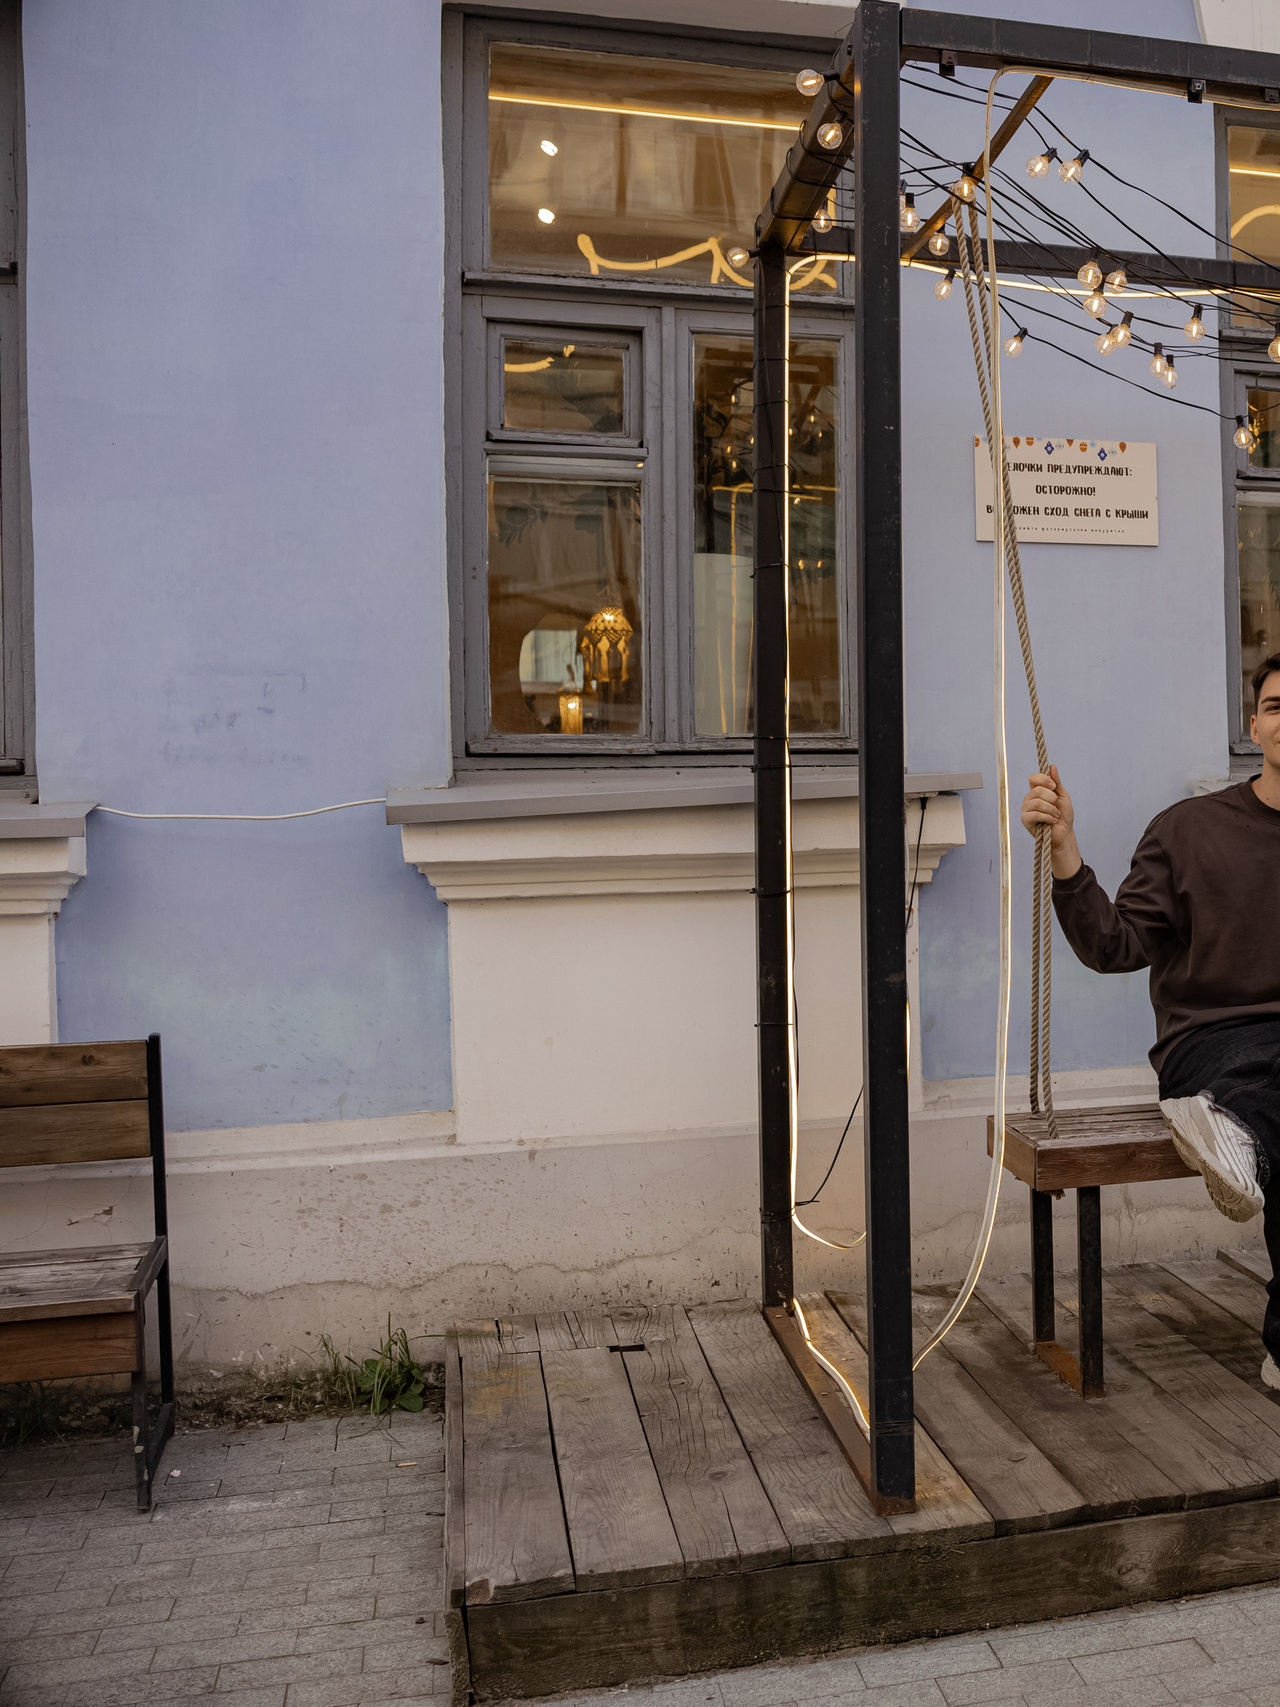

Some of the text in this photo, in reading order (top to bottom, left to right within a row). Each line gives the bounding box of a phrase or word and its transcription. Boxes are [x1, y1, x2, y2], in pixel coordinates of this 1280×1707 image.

[1006, 462, 1133, 477] ЕЛОЧКИ ПРЕДУПРЕЖДАЮТ:
[1035, 484, 1096, 496] ОСТОРОЖНО!
[986, 504, 1149, 519] ВОЖЕН СХОД СНЕГА С КРЫШИ
